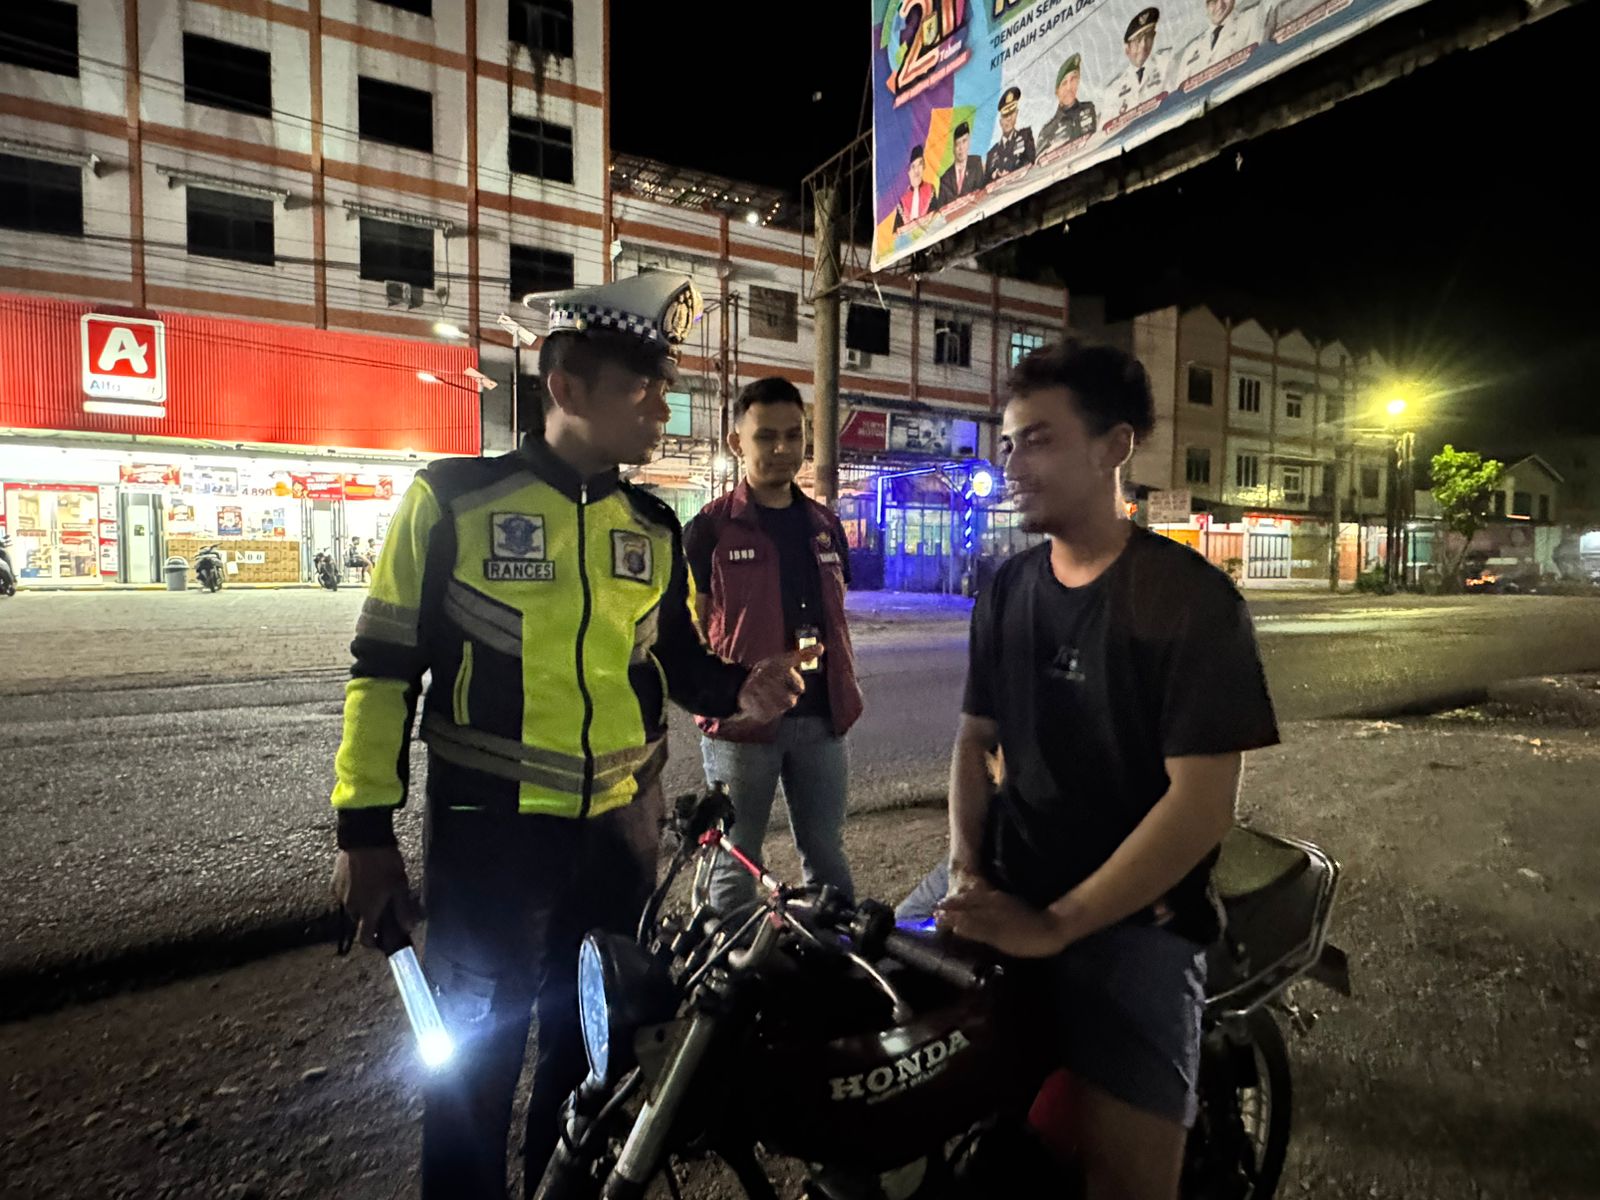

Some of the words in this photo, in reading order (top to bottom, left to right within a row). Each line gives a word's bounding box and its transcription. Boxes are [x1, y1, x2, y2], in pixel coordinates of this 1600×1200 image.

[990, 47, 1011, 71] KITA
[1012, 28, 1037, 56] RAIH
[1038, 5, 1074, 38] SAPTA
[1035, 0, 1062, 19] SEM
[829, 1030, 970, 1101] HONDA
